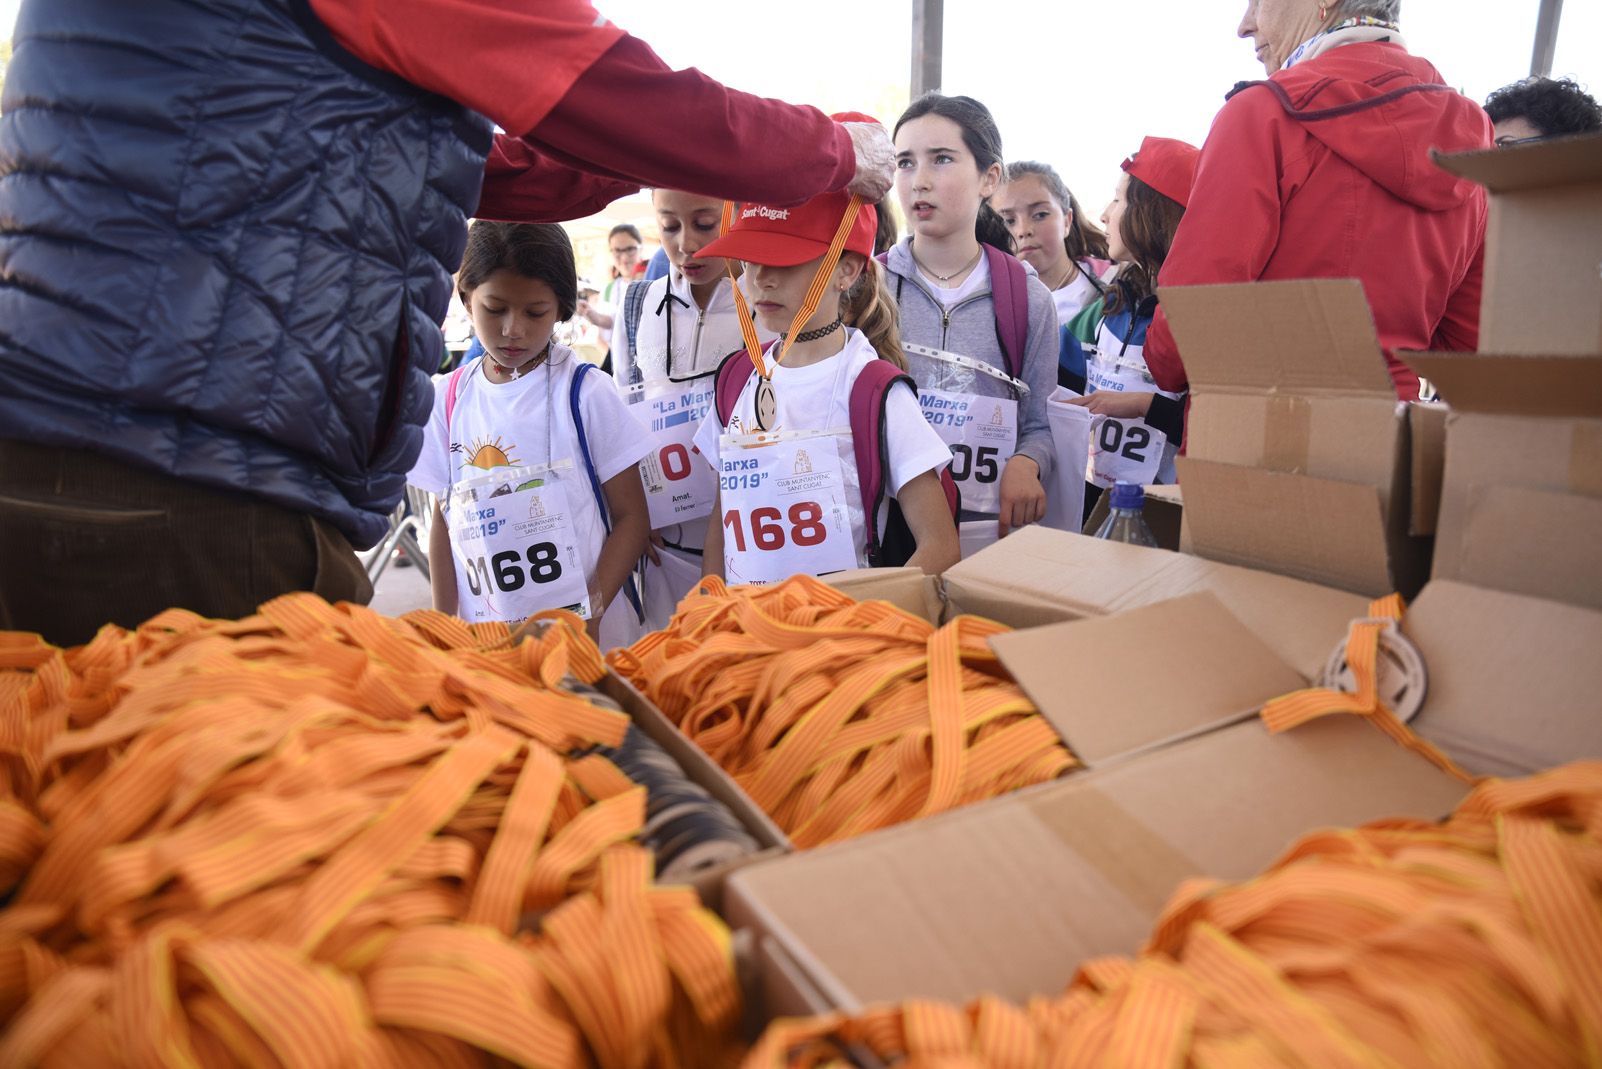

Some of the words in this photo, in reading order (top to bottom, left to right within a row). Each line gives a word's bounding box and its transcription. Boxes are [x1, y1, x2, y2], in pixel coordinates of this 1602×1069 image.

[760, 206, 790, 220] Cugat
[920, 395, 968, 411] Marxa
[1100, 419, 1150, 463] 02
[946, 444, 999, 484] 05
[787, 484, 801, 492] SANT
